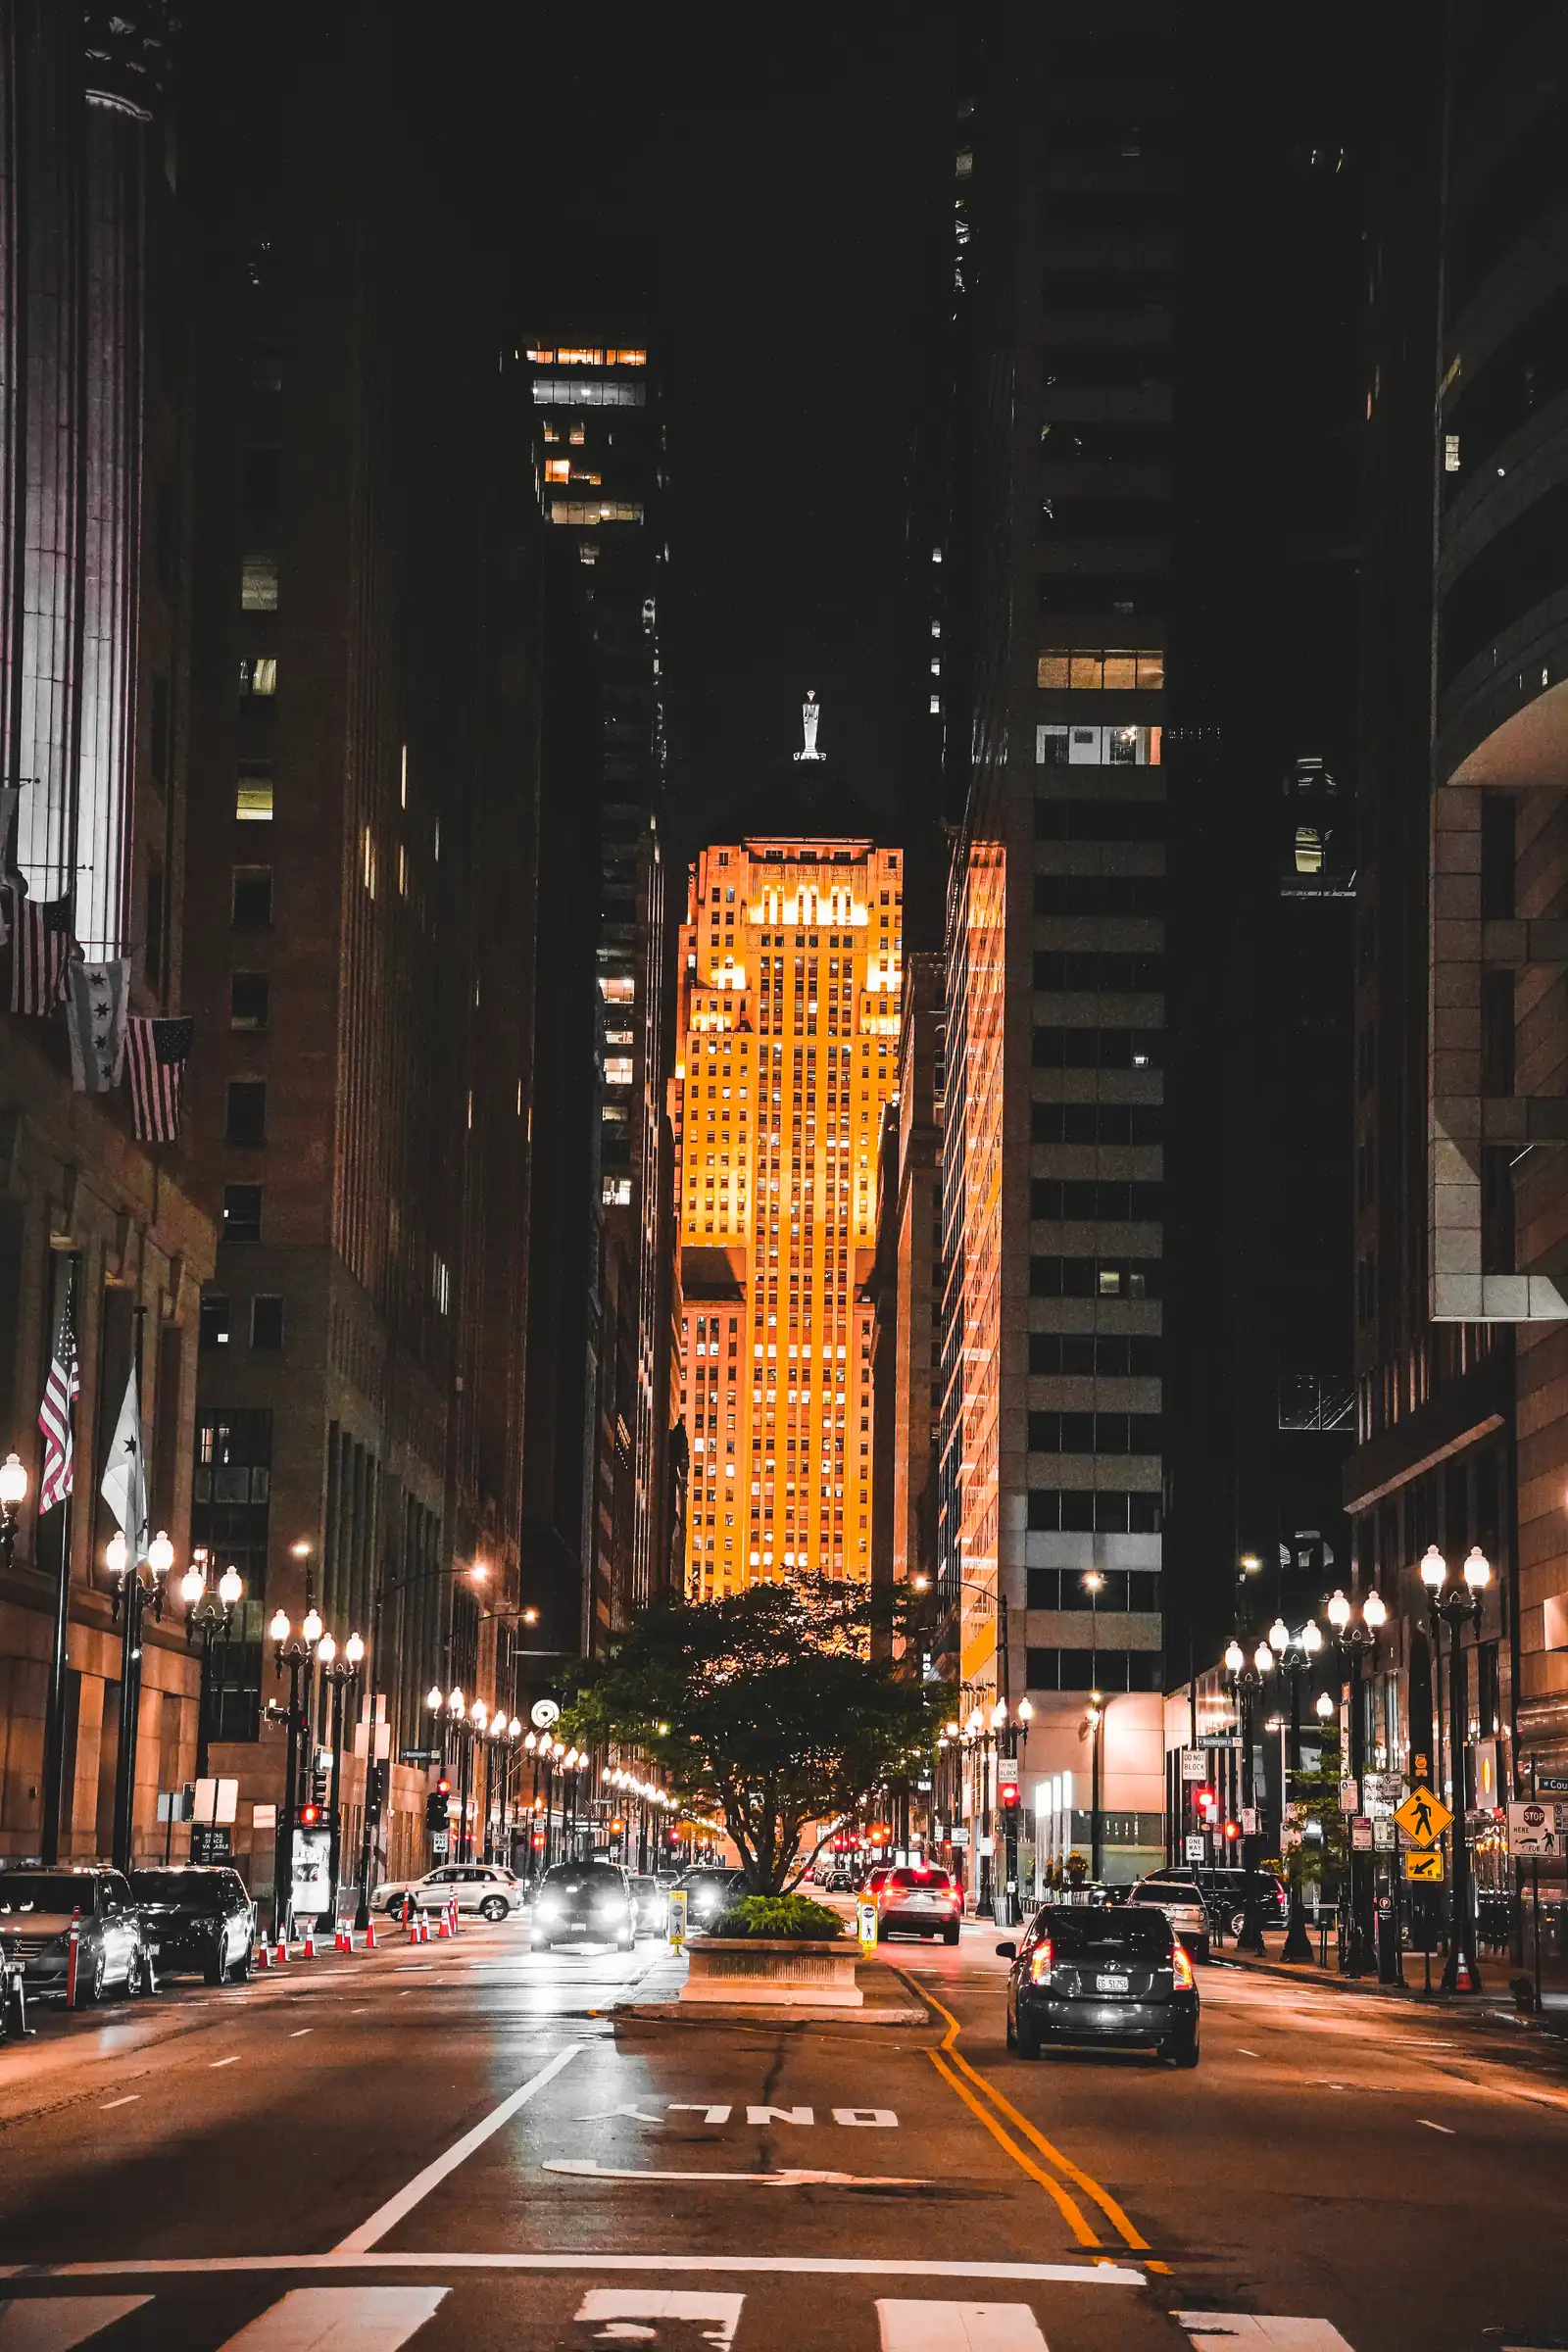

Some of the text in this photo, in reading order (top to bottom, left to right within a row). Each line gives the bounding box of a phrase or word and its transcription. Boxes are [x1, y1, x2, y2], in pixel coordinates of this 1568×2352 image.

[1524, 1811, 1544, 1821] STOP
[1513, 1826, 1530, 1835] HERE
[572, 2103, 899, 2127] ONLY
